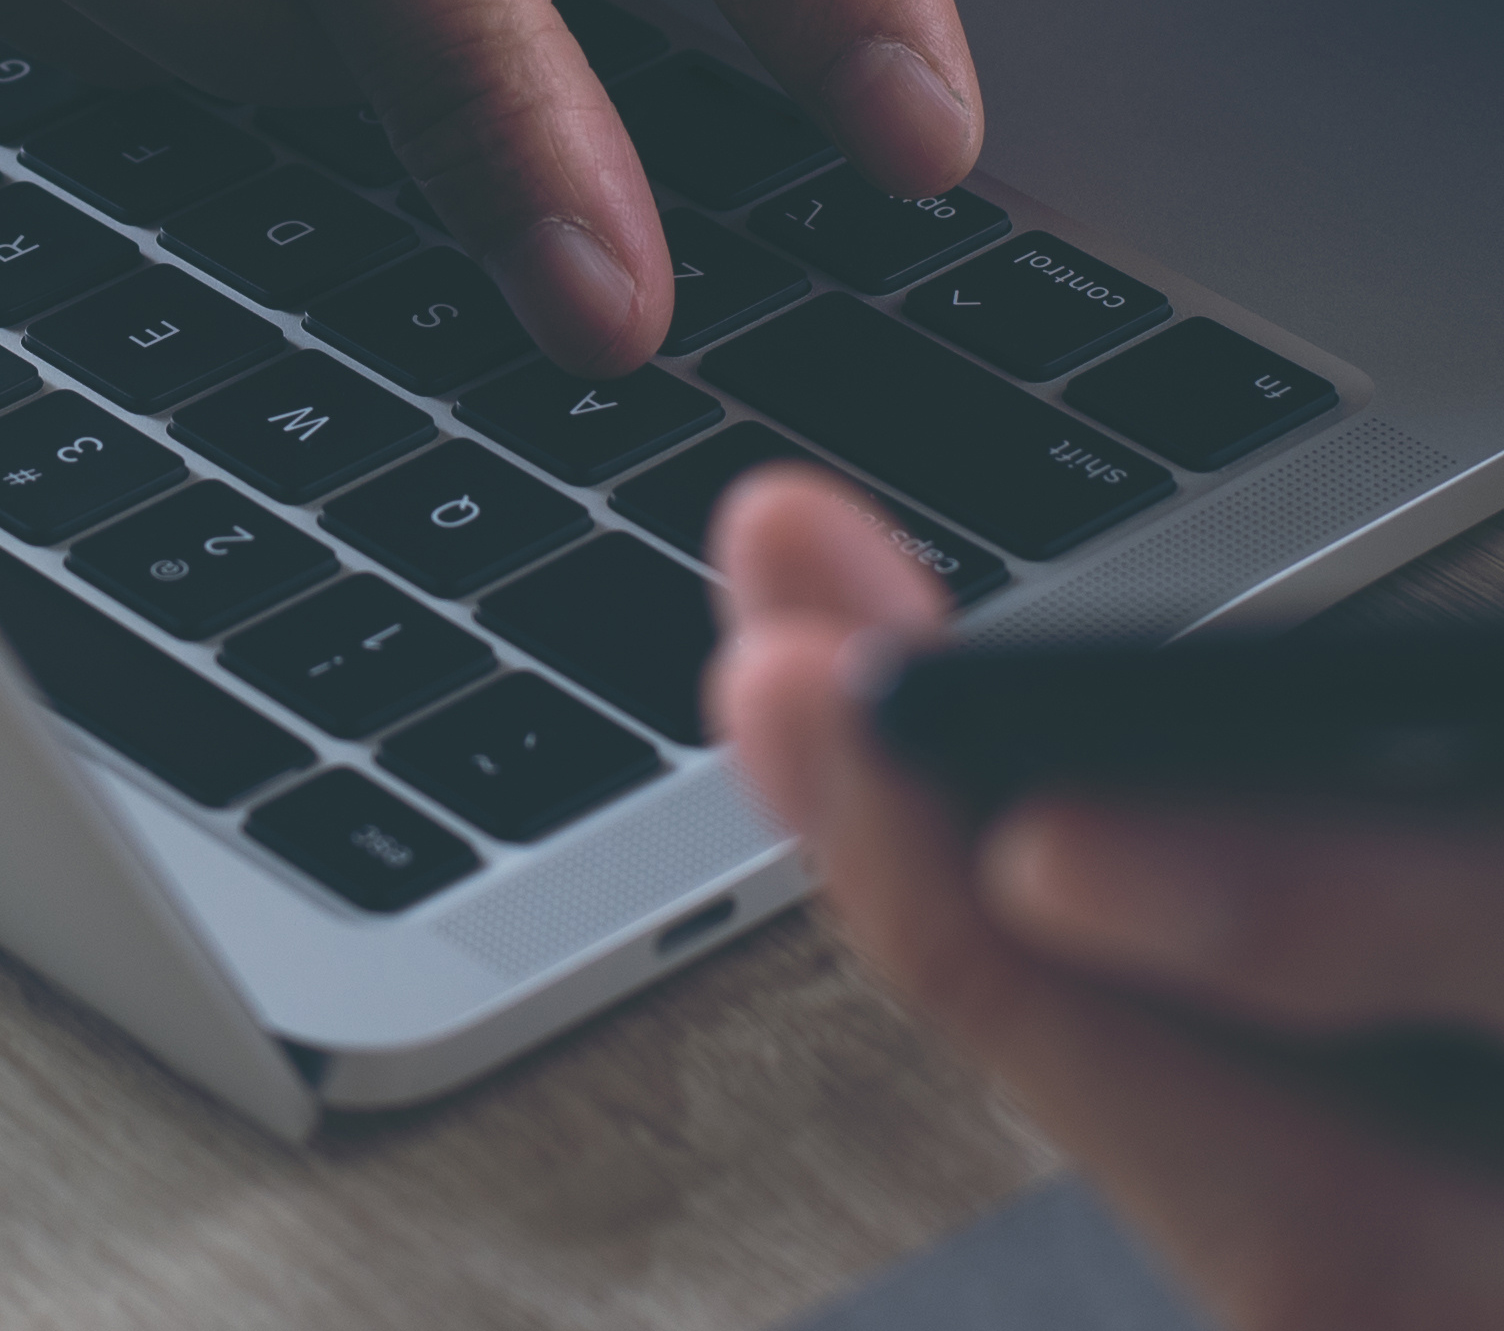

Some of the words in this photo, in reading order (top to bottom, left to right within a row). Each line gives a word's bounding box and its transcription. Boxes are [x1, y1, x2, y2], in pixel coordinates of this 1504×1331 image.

[122, 146, 168, 163] F
[267, 221, 314, 246] D
[1014, 249, 1127, 310] control
[412, 304, 458, 328] S
[129, 321, 179, 348] E
[1253, 374, 1293, 400] fn
[570, 391, 617, 415] A
[268, 407, 329, 441] W
[57, 437, 103, 462] 3
[1050, 438, 1129, 484] shift
[4, 469, 40, 484] #
[431, 495, 479, 527] Q
[204, 526, 253, 555] 2
